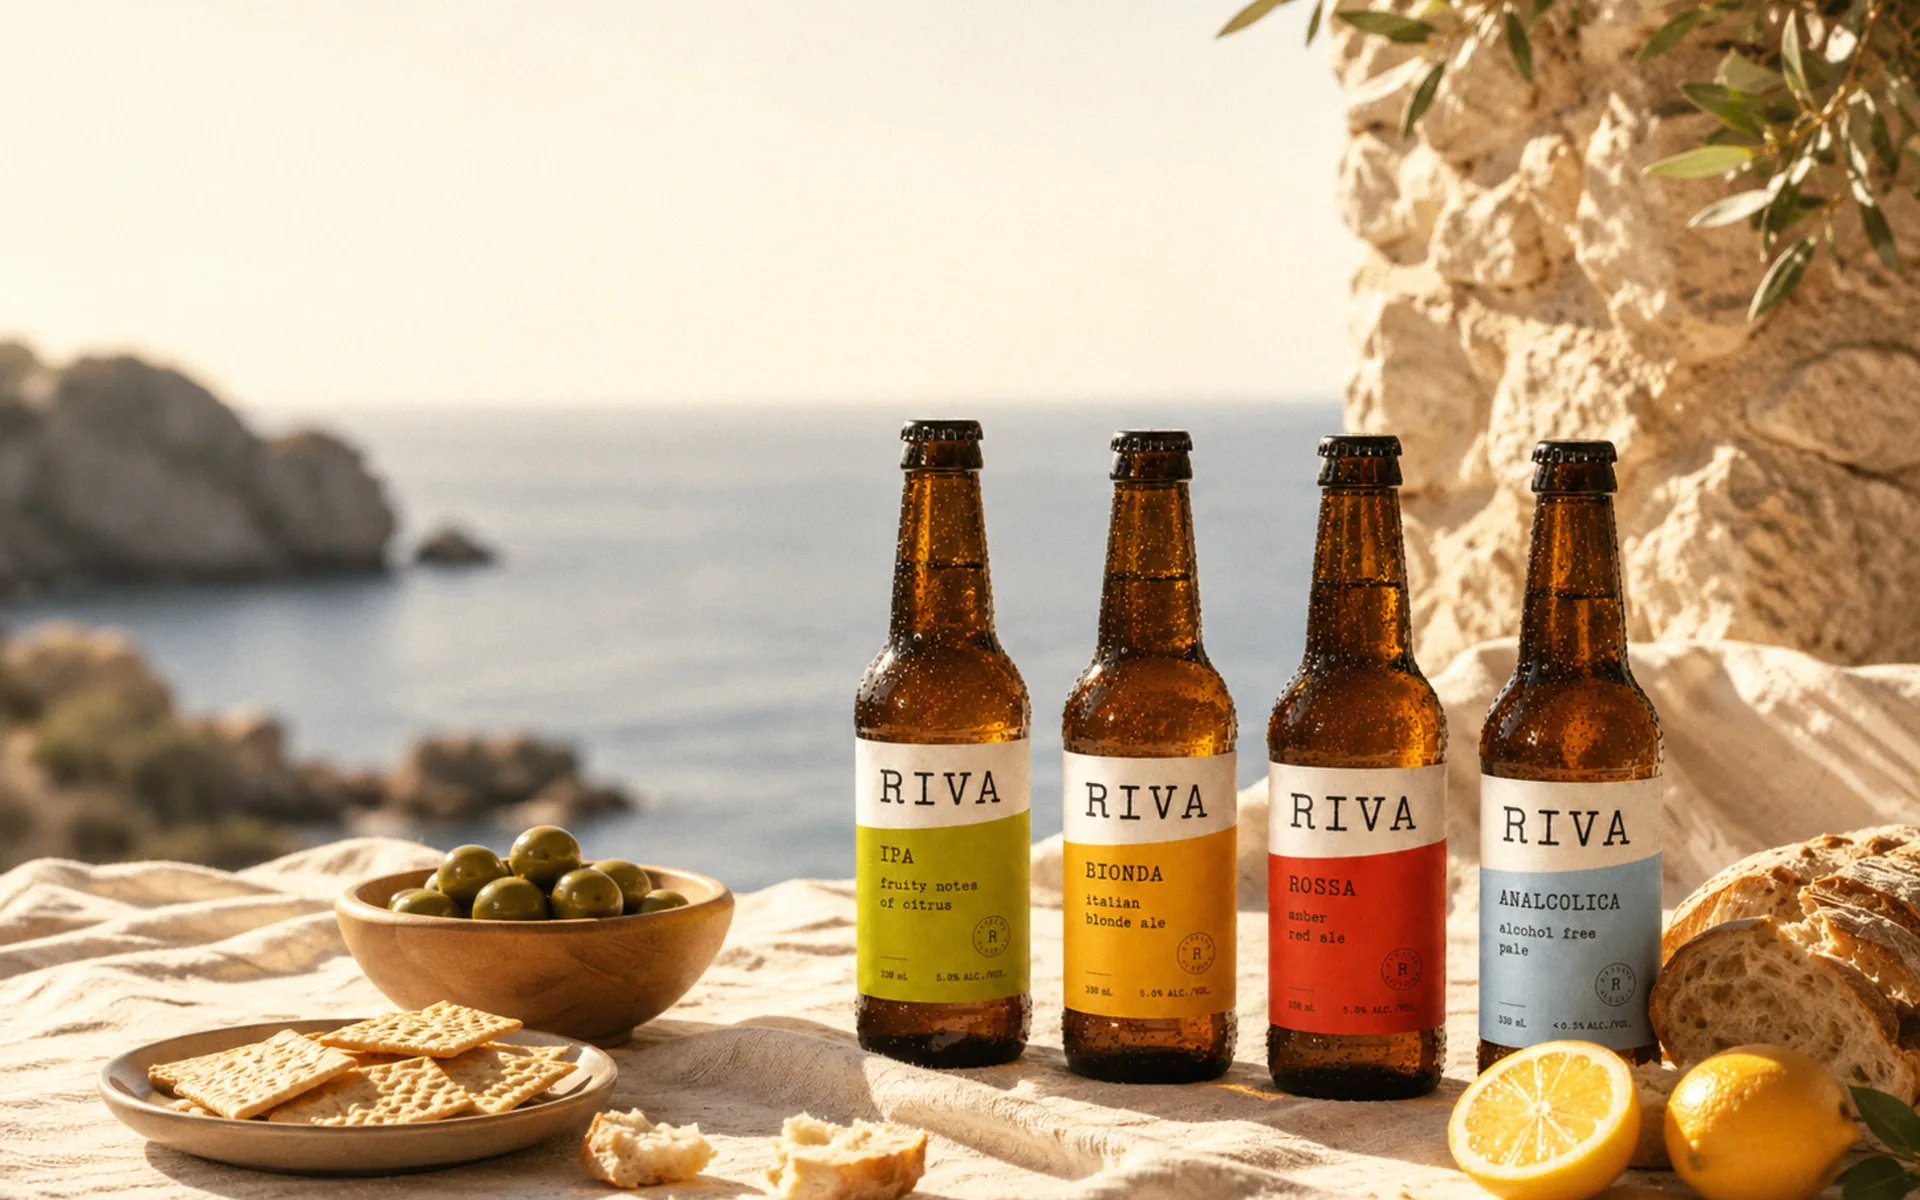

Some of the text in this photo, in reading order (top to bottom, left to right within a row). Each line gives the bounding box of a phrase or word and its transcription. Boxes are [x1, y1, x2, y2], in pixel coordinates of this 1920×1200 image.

[880, 768, 1001, 806] RIVA
[1085, 781, 1208, 820] RIVA
[1290, 792, 1416, 831] RIVA
[1502, 805, 1630, 847] RIVA
[880, 845, 914, 864] IPA
[1085, 861, 1164, 882] BIONDA
[880, 877, 978, 893] fruity notes
[1289, 875, 1356, 896] ROSSA
[880, 897, 952, 911] of citrus
[1085, 894, 1141, 909] italian
[1499, 889, 1621, 911] ANALCOLICA
[1085, 912, 1166, 929] blonde ale
[1288, 909, 1327, 923] amber
[988, 930, 997, 943] R
[1288, 930, 1345, 944] red ale
[1499, 922, 1596, 940] alcohol free
[1193, 947, 1202, 960] R
[1499, 943, 1529, 956] pale
[1398, 962, 1408, 976] R
[1611, 977, 1621, 991] R
[1498, 1015, 1512, 1026] 330
